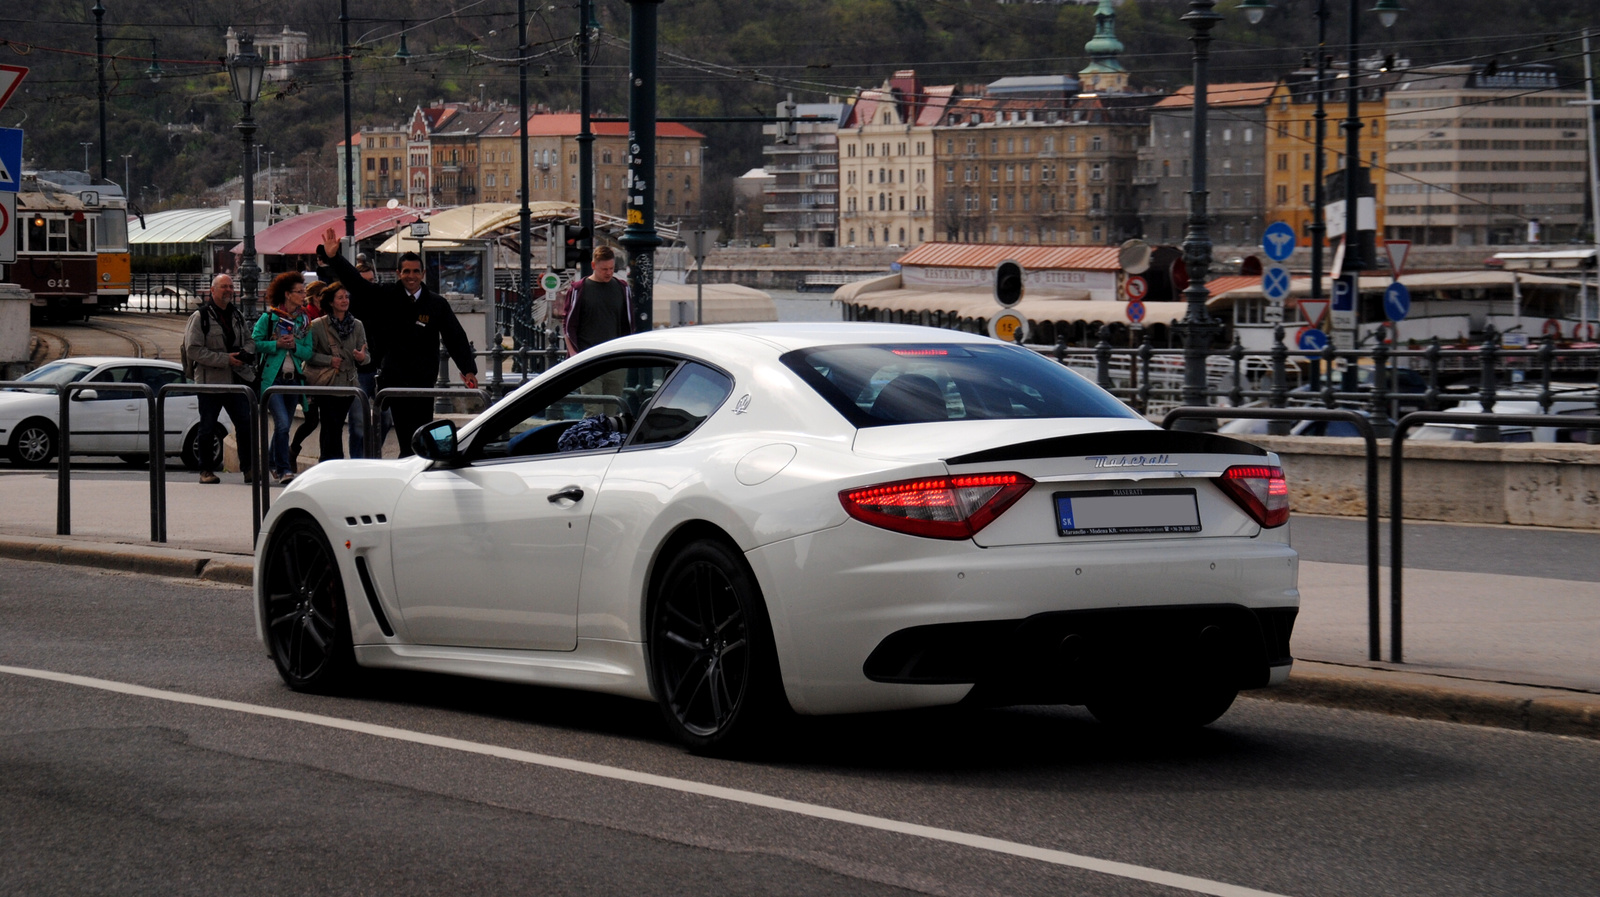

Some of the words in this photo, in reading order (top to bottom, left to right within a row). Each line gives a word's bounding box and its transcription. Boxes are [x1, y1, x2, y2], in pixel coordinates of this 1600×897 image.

[86, 194, 93, 204] 2
[925, 269, 975, 280] RESTAURANT
[1333, 281, 1349, 304] P
[1002, 323, 1013, 332] 15
[1085, 455, 1178, 468] Maserati
[1062, 518, 1072, 526] SK
